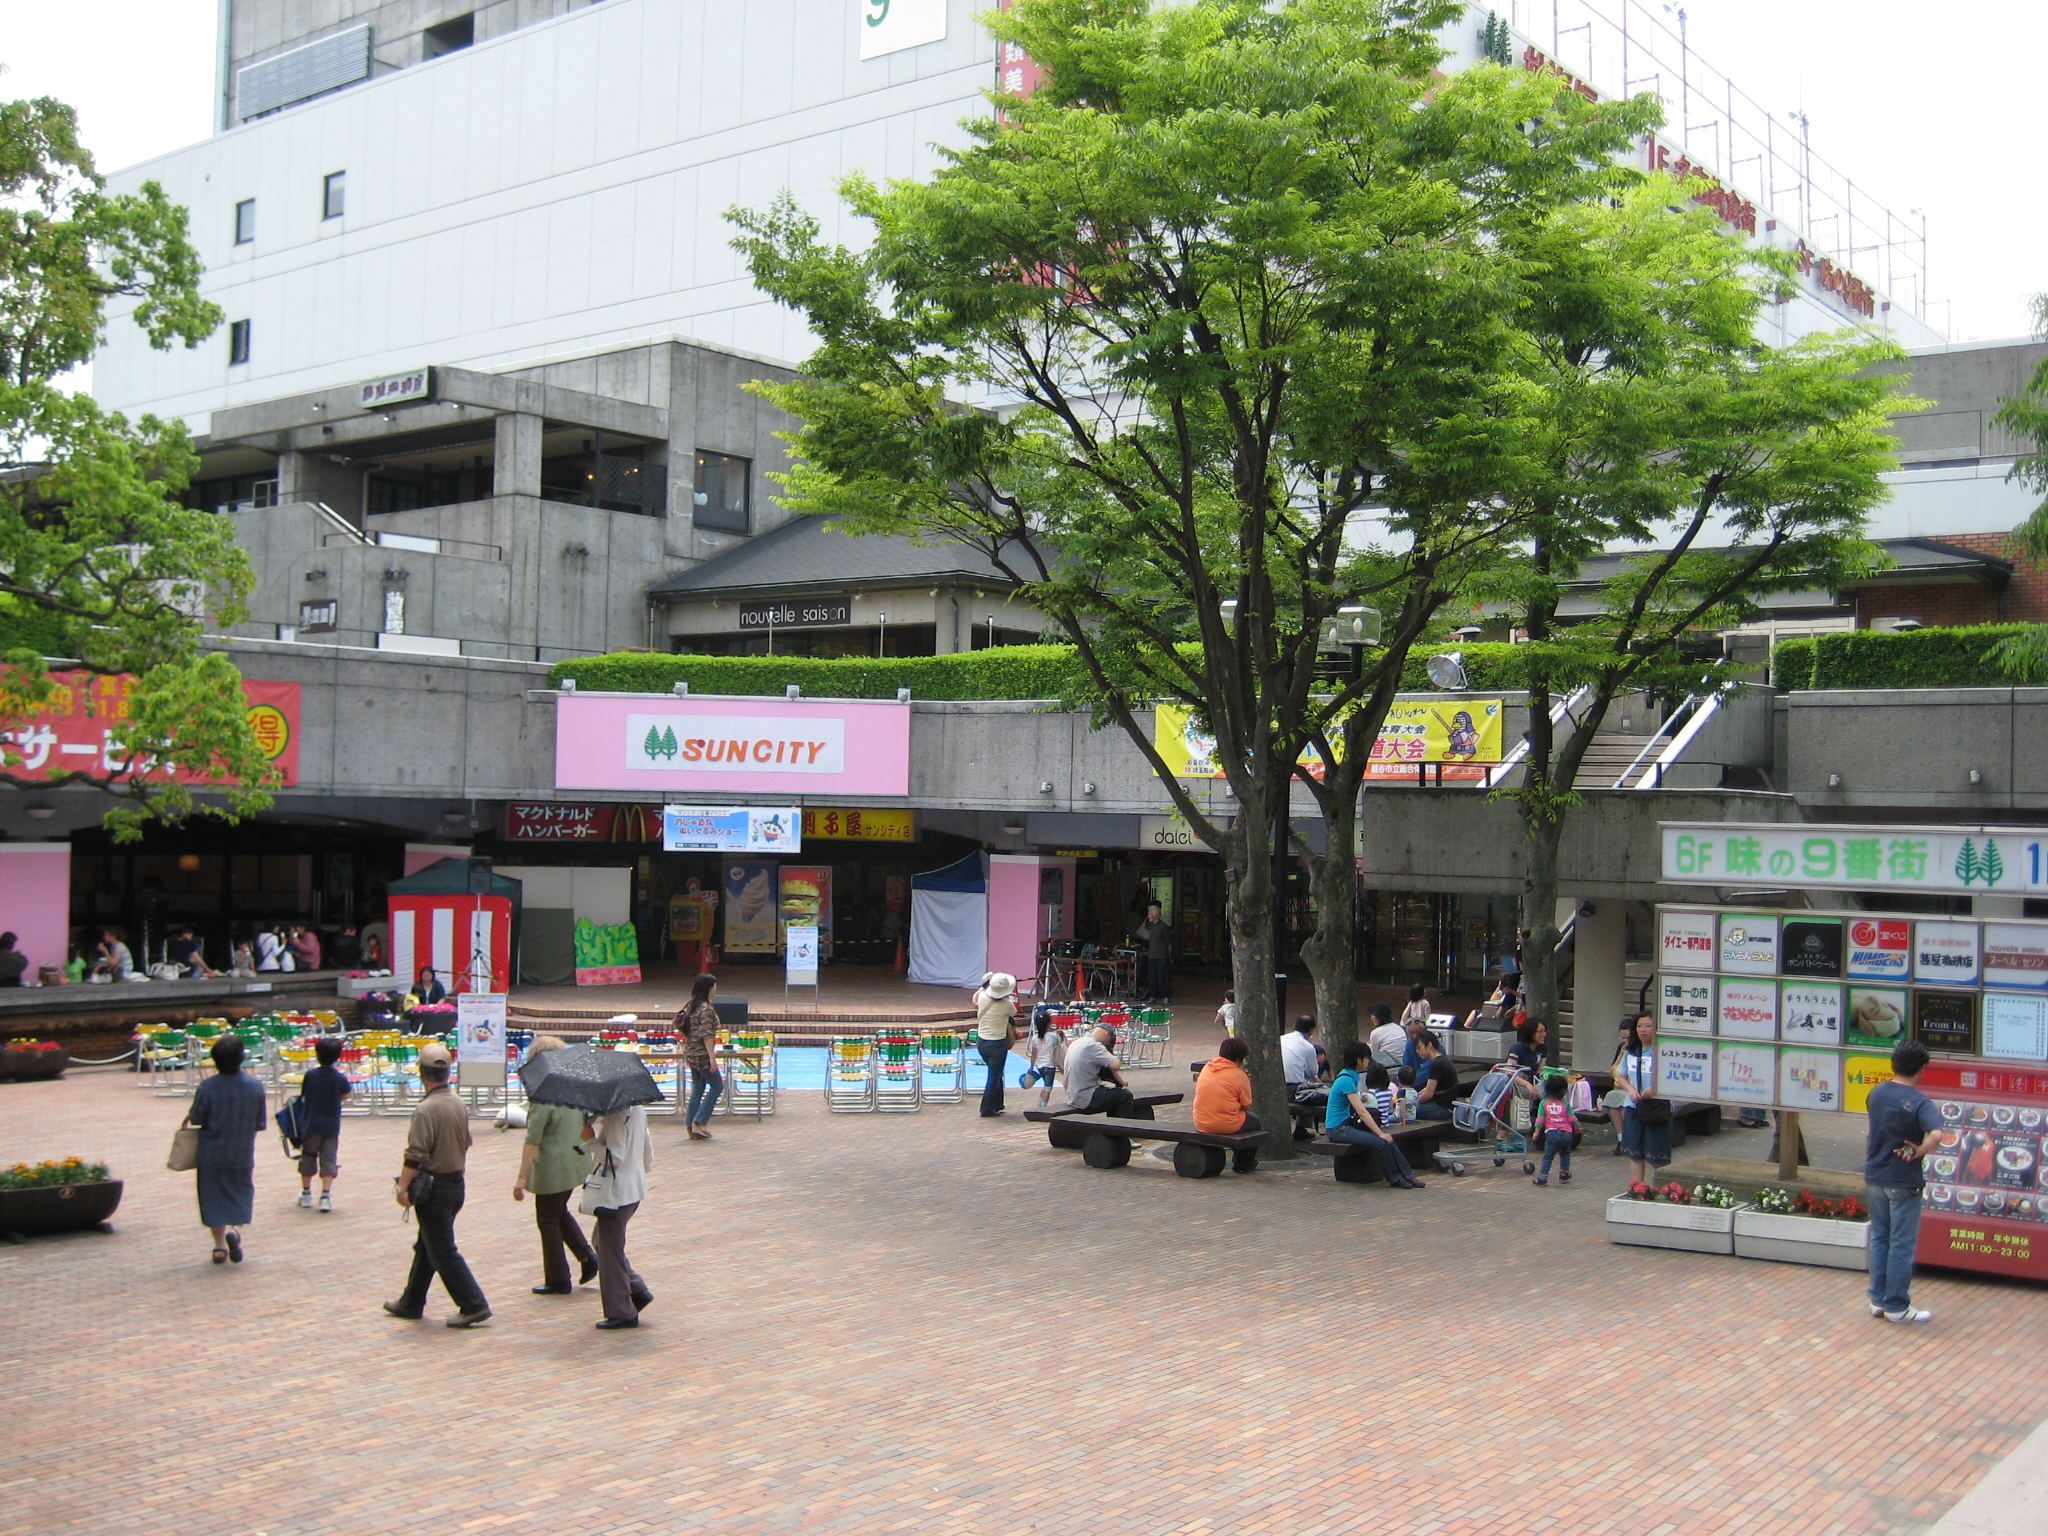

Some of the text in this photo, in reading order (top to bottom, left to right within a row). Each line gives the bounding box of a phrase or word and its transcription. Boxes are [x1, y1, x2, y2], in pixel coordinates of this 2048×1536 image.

[741, 604, 795, 625] nouvelle
[515, 806, 595, 821] マクドナルド
[517, 824, 598, 838] ハンバーガー
[865, 824, 910, 838] サンシティ店
[1676, 834, 1928, 882] 6F 味の9番街
[1880, 931, 1907, 940] 宝くじ
[1819, 1092, 1834, 1102] 3F
[1949, 1228, 2030, 1246] 営業時間 年中無休
